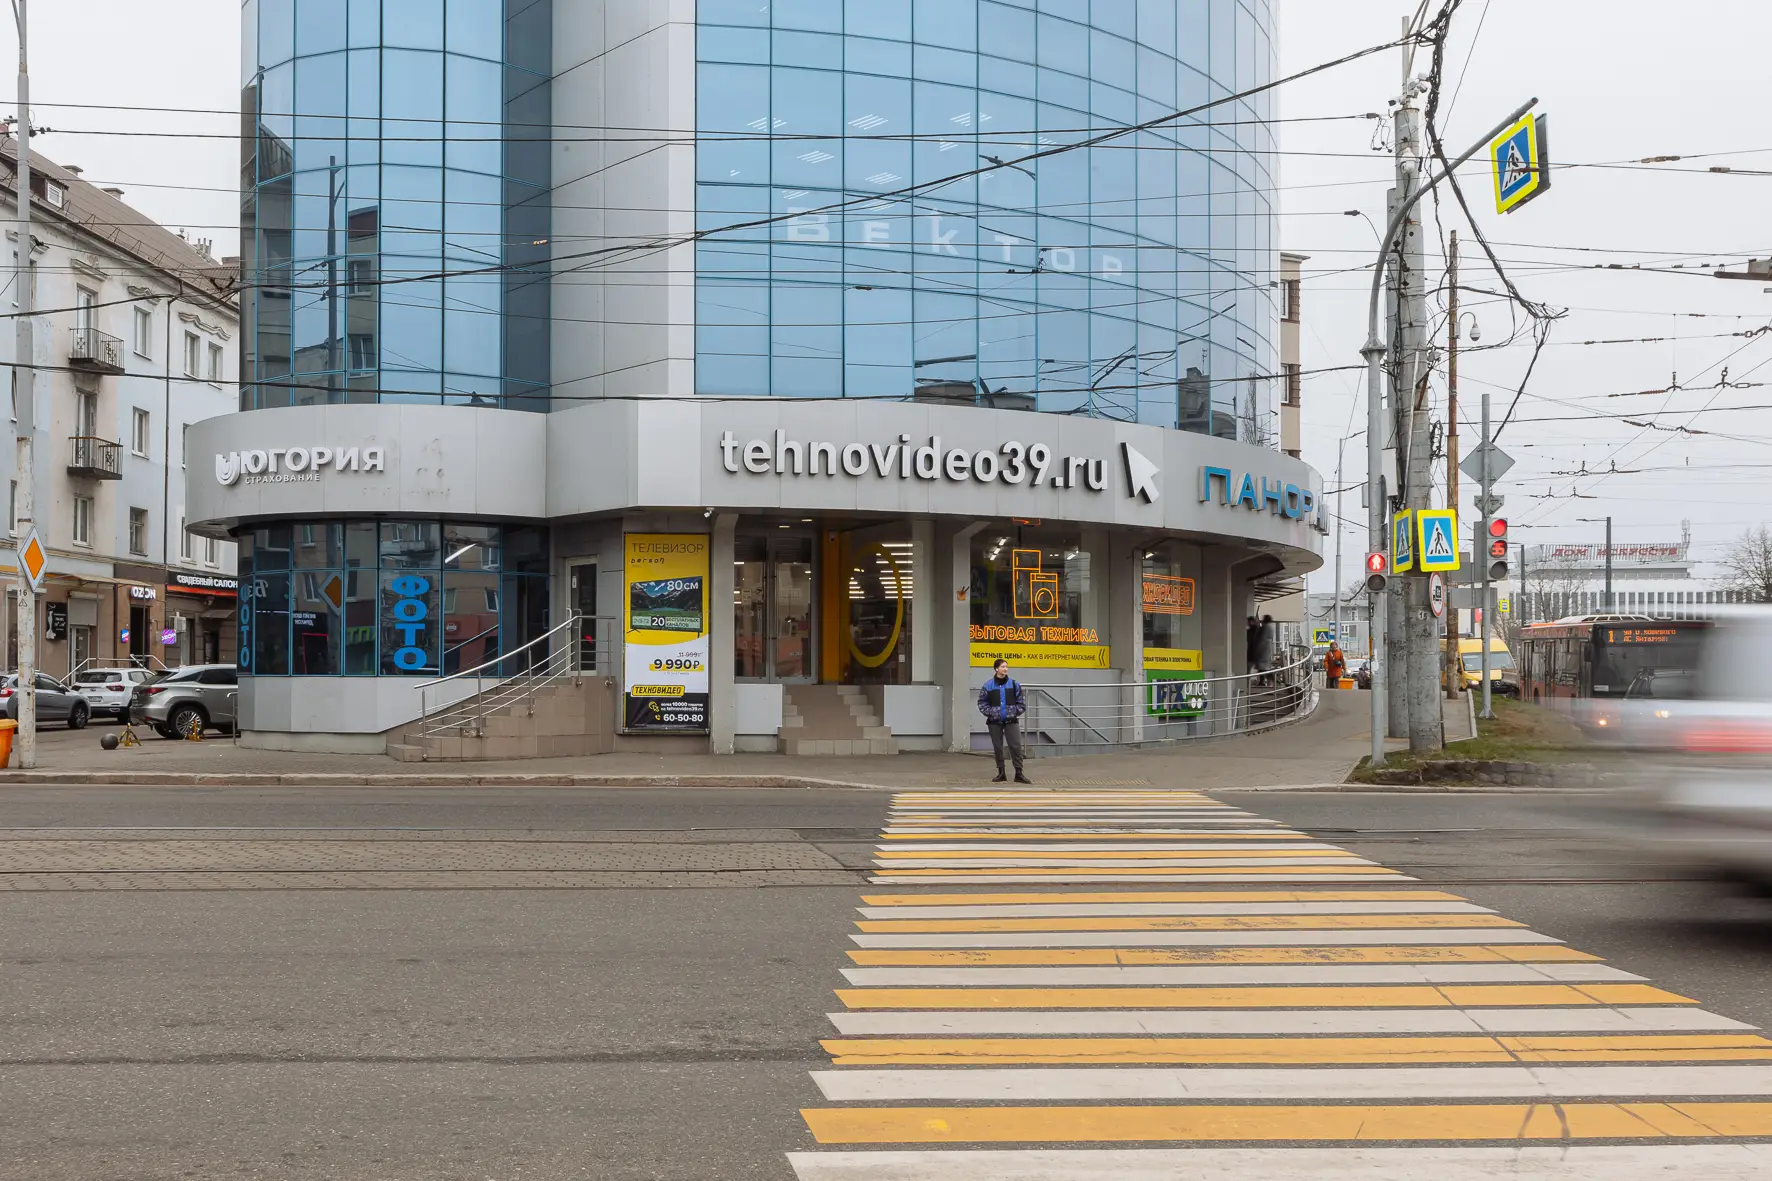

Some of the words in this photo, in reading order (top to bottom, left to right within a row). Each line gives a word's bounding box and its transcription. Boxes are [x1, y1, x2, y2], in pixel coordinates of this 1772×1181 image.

[240, 447, 386, 475] ЮГОРИЯ
[719, 428, 1108, 491] tehnovideo39.ru
[244, 473, 321, 485] СТРАХОВАНИЕ
[631, 542, 704, 554] ТЕЛЕВИЗОР
[1552, 548, 1588, 557] ДОМ
[176, 574, 214, 586] СВАДЕБНЫЙ
[213, 579, 238, 588] САЛОН
[667, 580, 683, 590] 80
[240, 583, 250, 668] ФОТО
[391, 575, 430, 670] ФОТО
[651, 616, 665, 626] 20
[970, 625, 1036, 642] БЫТОВАЯ
[1040, 626, 1099, 643] ТЕХНИКА
[1608, 630, 1615, 642] 1
[1004, 652, 1022, 660] ЦЕНЫ
[1044, 653, 1071, 661] ИНТЕРНЕТ
[653, 658, 663, 670] 9
[635, 686, 682, 695] ТЕХНОВИДЕО
[663, 713, 704, 722] 60-50-80
